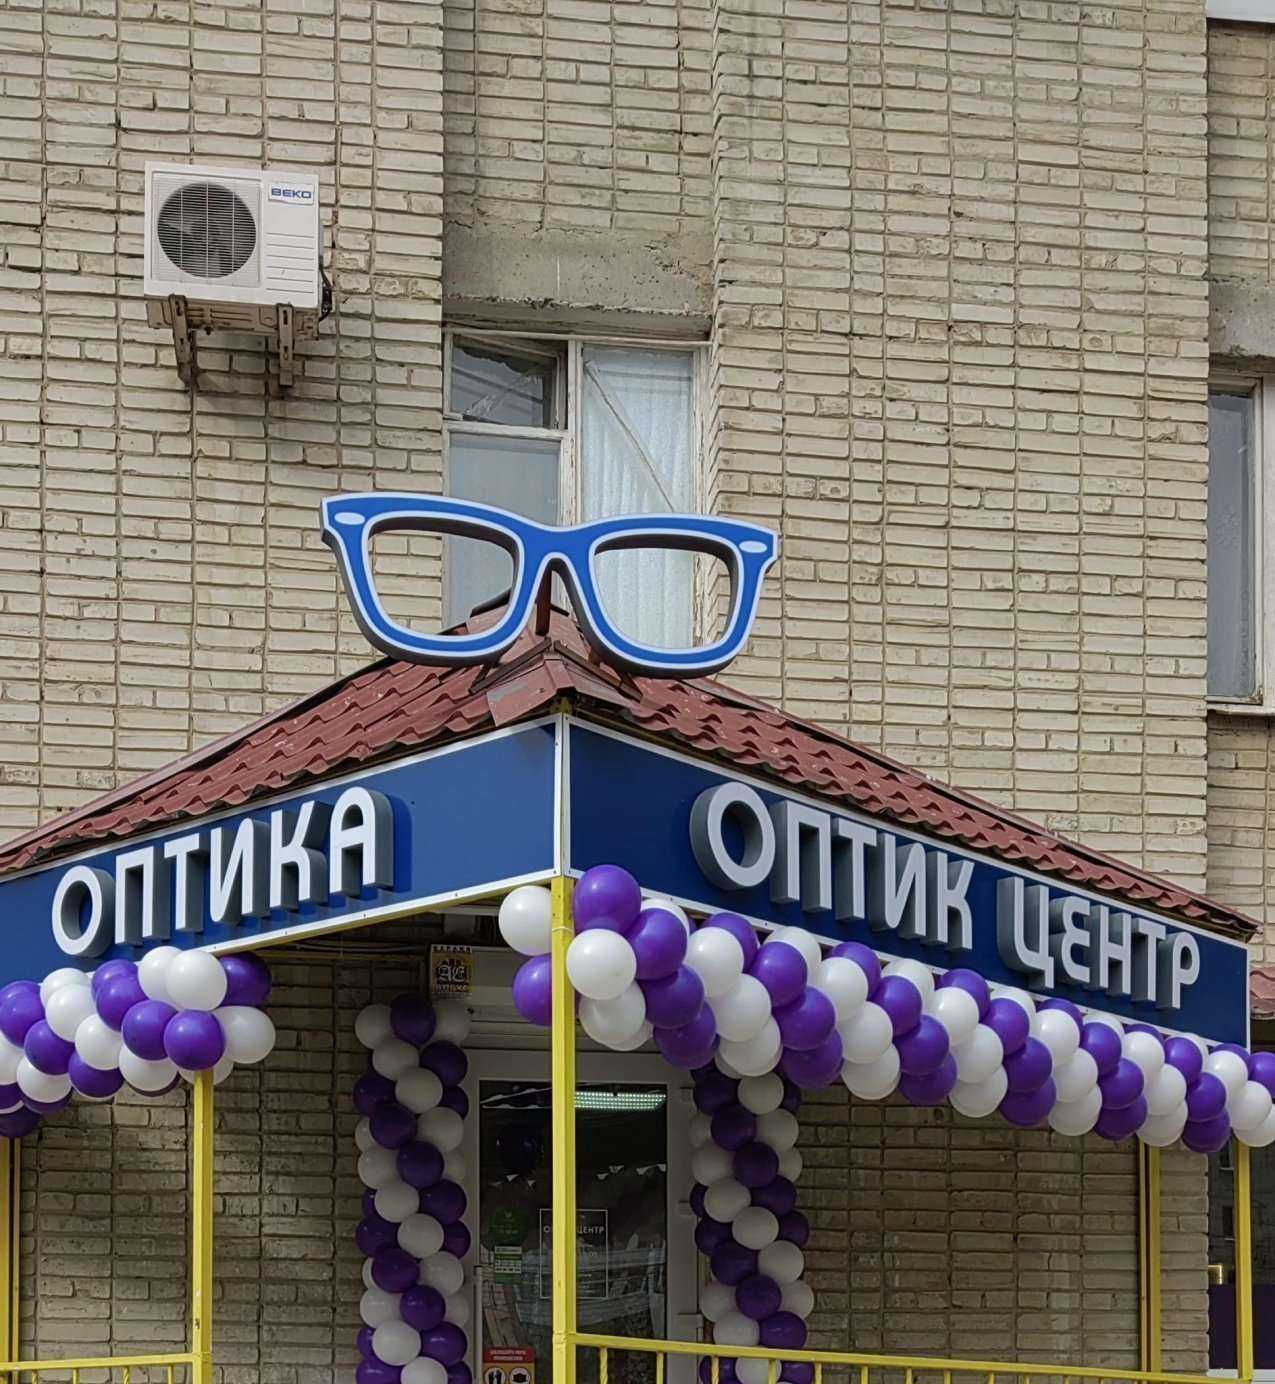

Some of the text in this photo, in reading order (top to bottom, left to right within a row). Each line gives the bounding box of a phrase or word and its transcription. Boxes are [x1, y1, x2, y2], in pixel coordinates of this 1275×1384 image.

[271, 188, 312, 199] BEKO
[52, 786, 393, 957] ОПТИКА
[690, 782, 1200, 1010] ОПТИК ЦЕНТР
